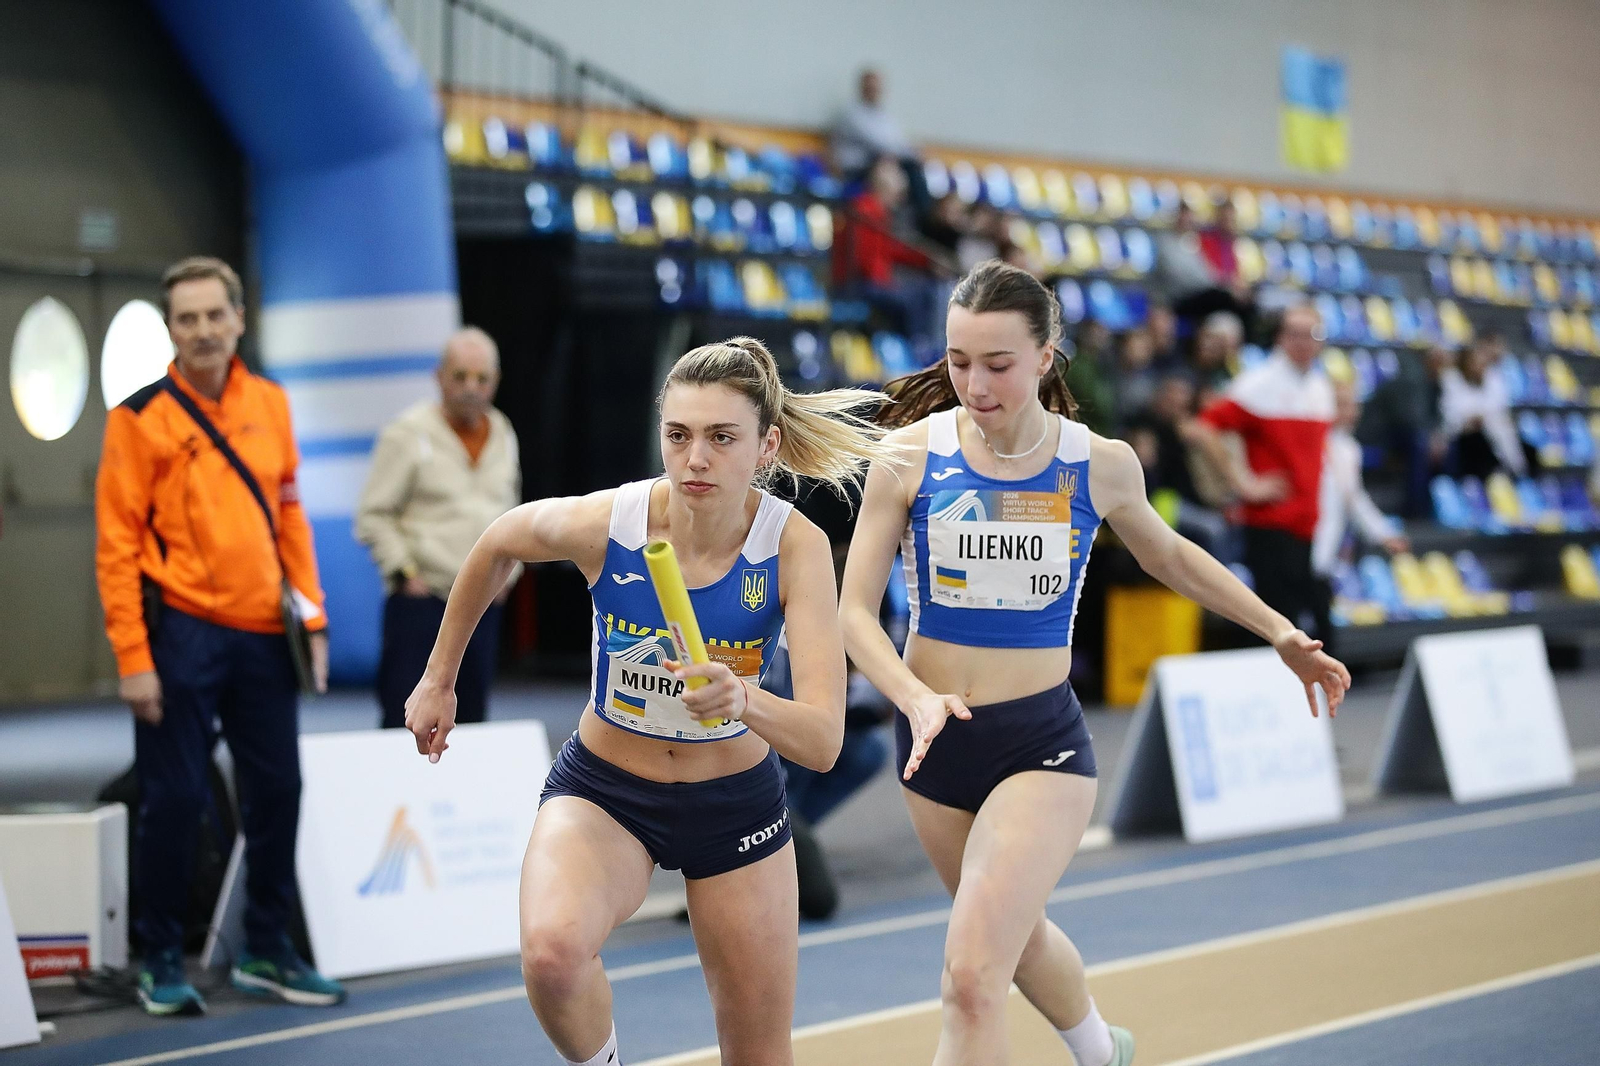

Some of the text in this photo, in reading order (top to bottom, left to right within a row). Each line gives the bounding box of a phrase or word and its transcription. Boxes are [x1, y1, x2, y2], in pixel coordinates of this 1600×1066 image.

[958, 534, 1043, 561] ILIENKO
[1029, 574, 1062, 595] 102
[714, 654, 743, 662] WORLD
[621, 668, 685, 698] MURA
